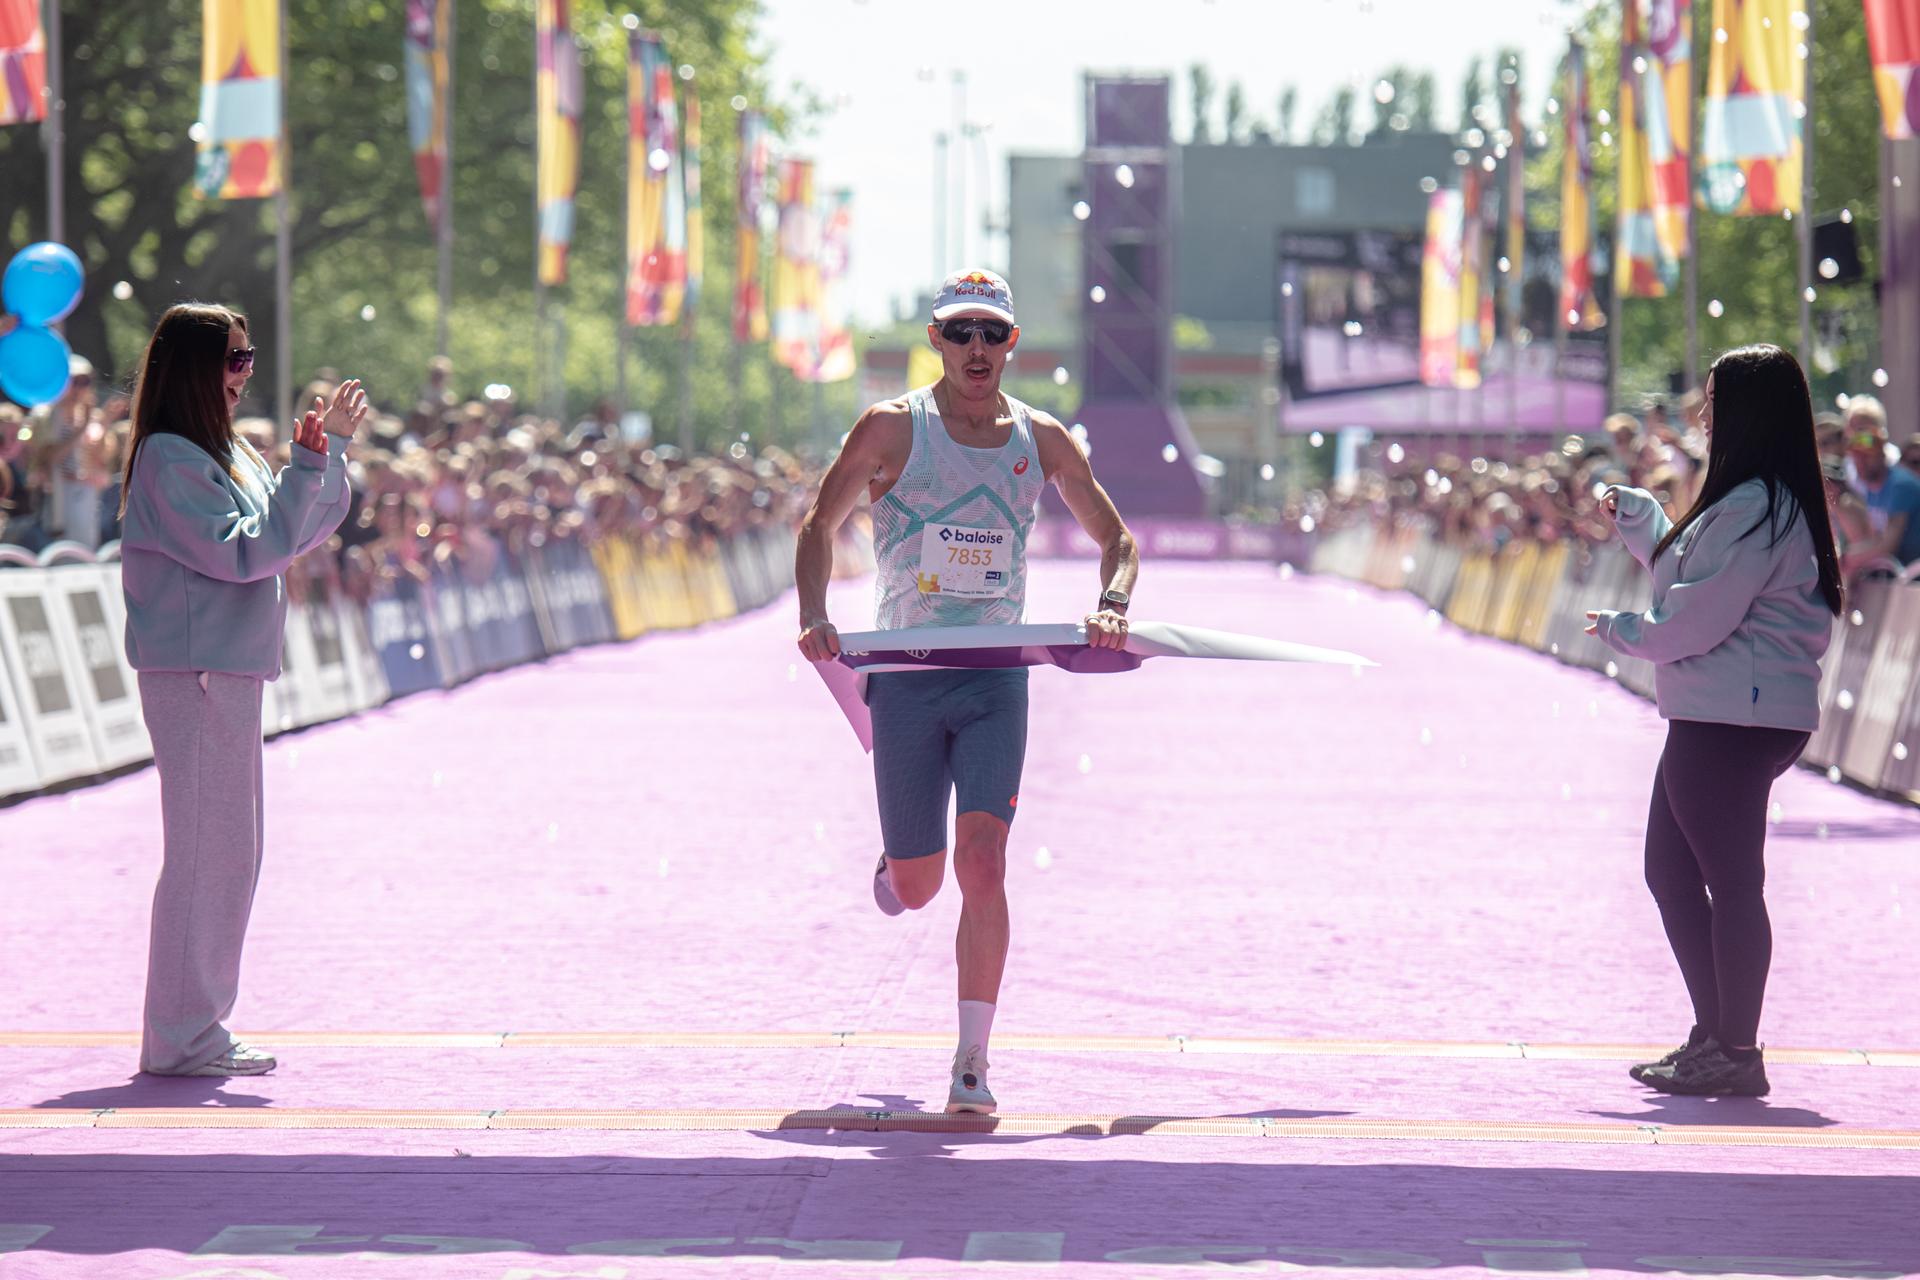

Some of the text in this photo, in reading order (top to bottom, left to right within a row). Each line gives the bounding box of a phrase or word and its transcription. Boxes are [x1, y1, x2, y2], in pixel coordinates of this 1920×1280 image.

[954, 286, 996, 299] Red Bull
[954, 529, 1003, 544] baloise
[947, 546, 993, 566] 7853
